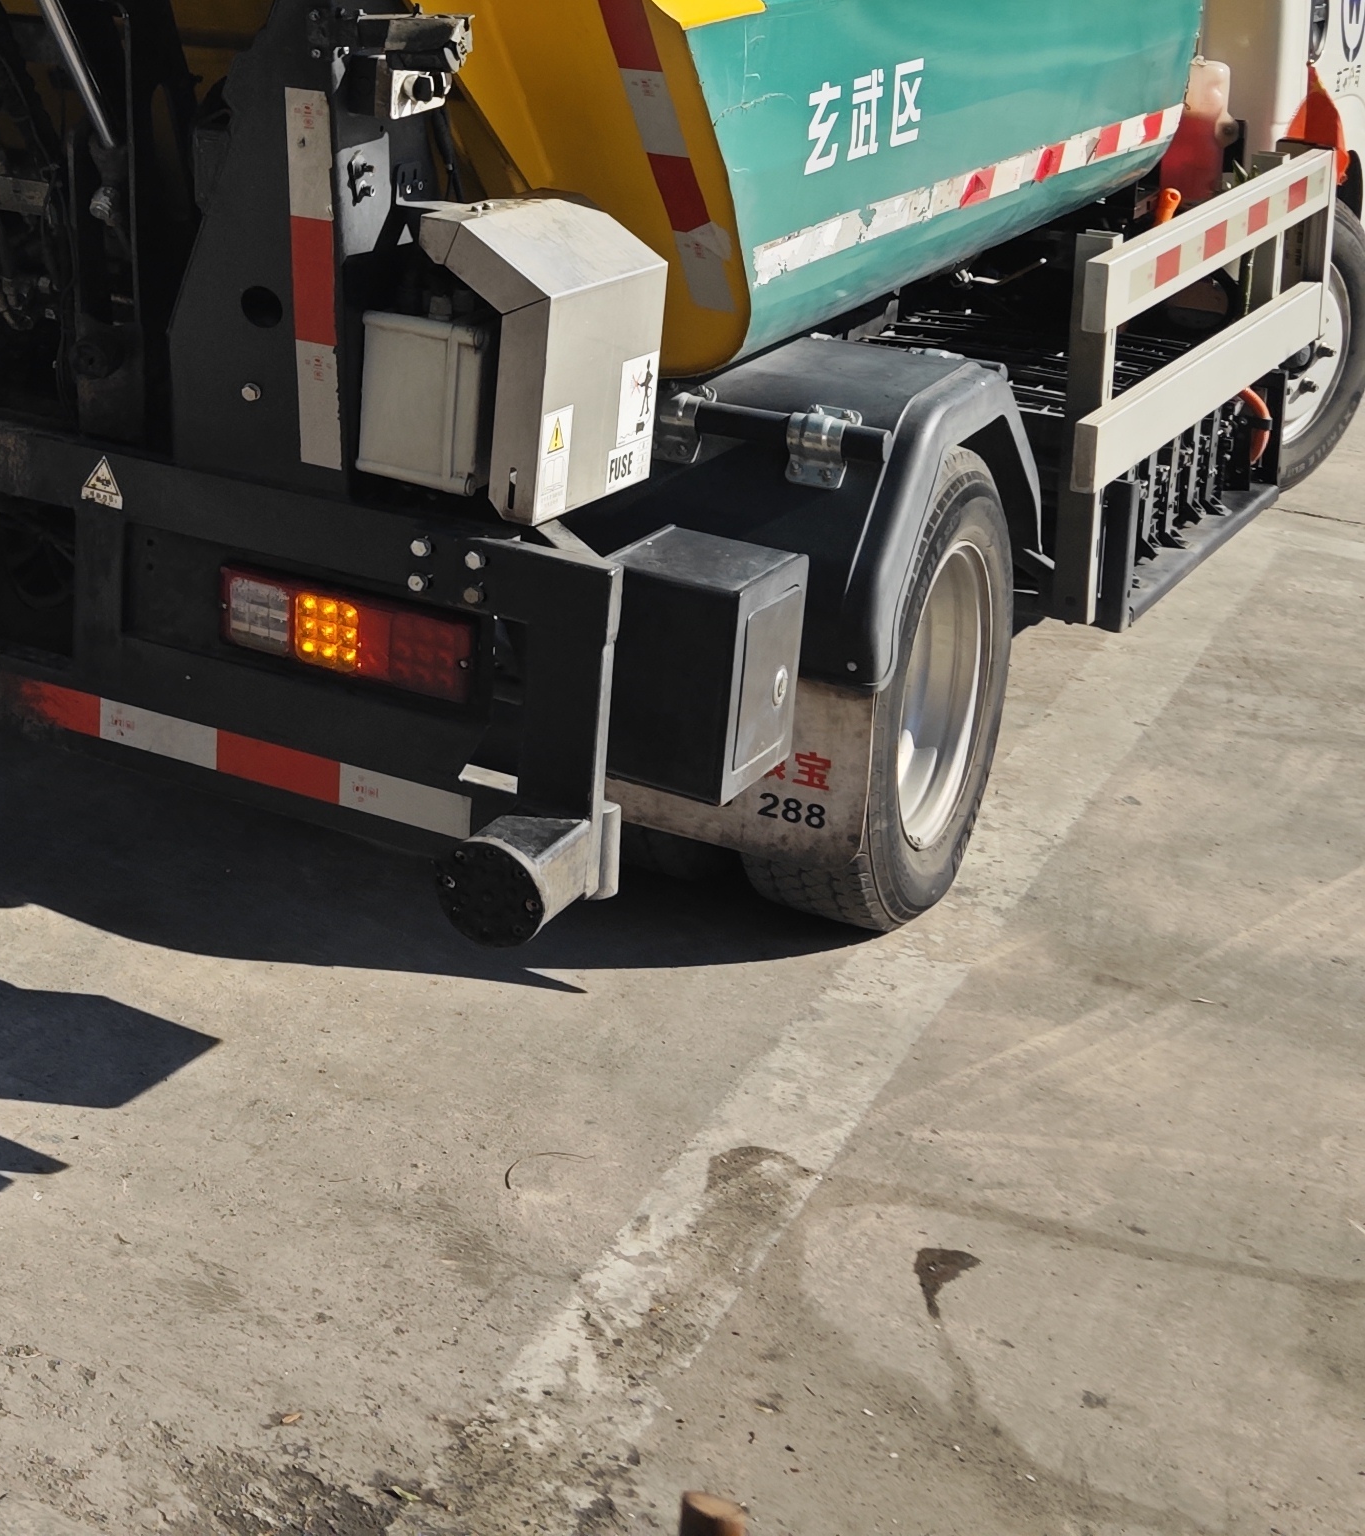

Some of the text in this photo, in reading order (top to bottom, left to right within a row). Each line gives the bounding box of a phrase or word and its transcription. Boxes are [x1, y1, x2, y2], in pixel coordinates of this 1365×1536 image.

[803, 57, 925, 176] 玄武区
[608, 451, 634, 484] FUSE
[757, 792, 826, 830] 288
